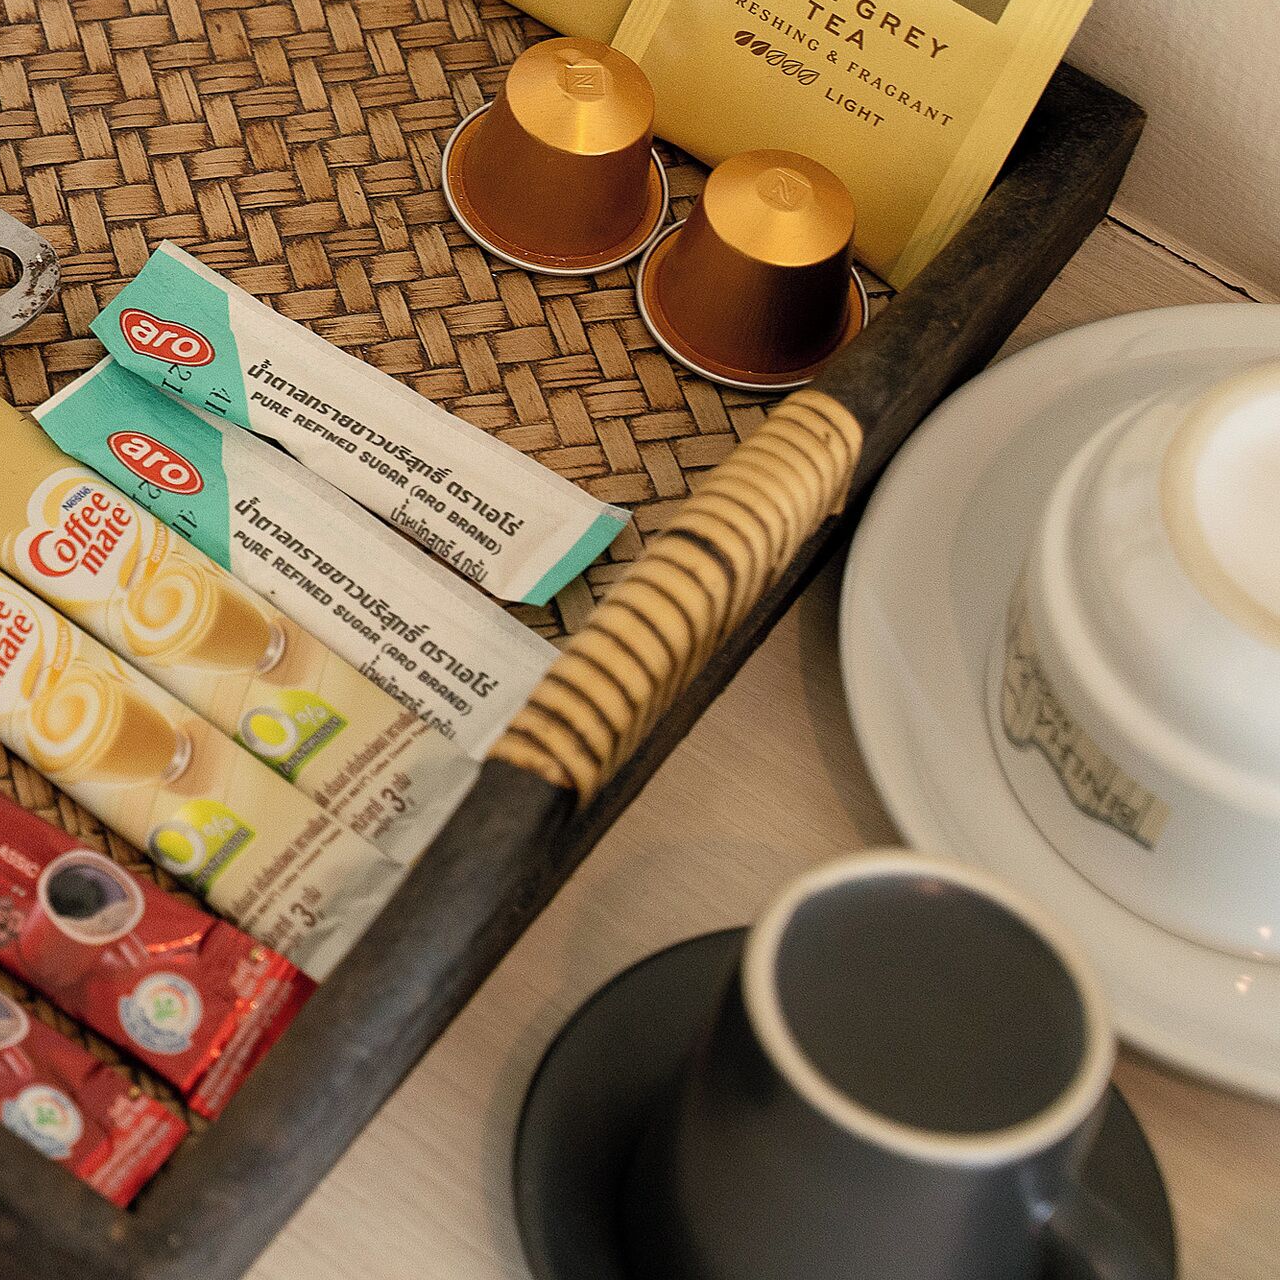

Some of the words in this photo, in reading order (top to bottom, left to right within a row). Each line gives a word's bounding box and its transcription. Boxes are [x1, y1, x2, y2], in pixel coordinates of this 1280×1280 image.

[806, 0, 865, 51] TEA
[856, 0, 950, 60] GREY
[825, 87, 885, 129] LIGHT
[826, 49, 838, 64] &
[846, 61, 954, 127] FRAGRANT
[130, 317, 201, 359] aro
[118, 437, 191, 486] aro
[246, 358, 454, 486] น้ำตาลทรายขาวบริสุทธิ์
[447, 479, 528, 539] ตราเอโร่
[250, 390, 293, 417] PURE
[293, 413, 358, 456] REFINED
[359, 451, 410, 490] SUGAR
[409, 484, 445, 514] (ARO
[446, 509, 504, 556] BRAND)
[28, 491, 111, 578] Coffee
[80, 505, 133, 576] mate
[233, 495, 431, 644] น้ำตาลทรายขาวบริสุทธิ์
[451, 549, 463, 566] 4
[461, 553, 489, 583] กรัม
[233, 529, 270, 562] PURE
[270, 557, 334, 606] REFINED
[333, 603, 381, 646] SUGAR
[381, 642, 418, 674] (ARO
[417, 669, 474, 717] BRAND)
